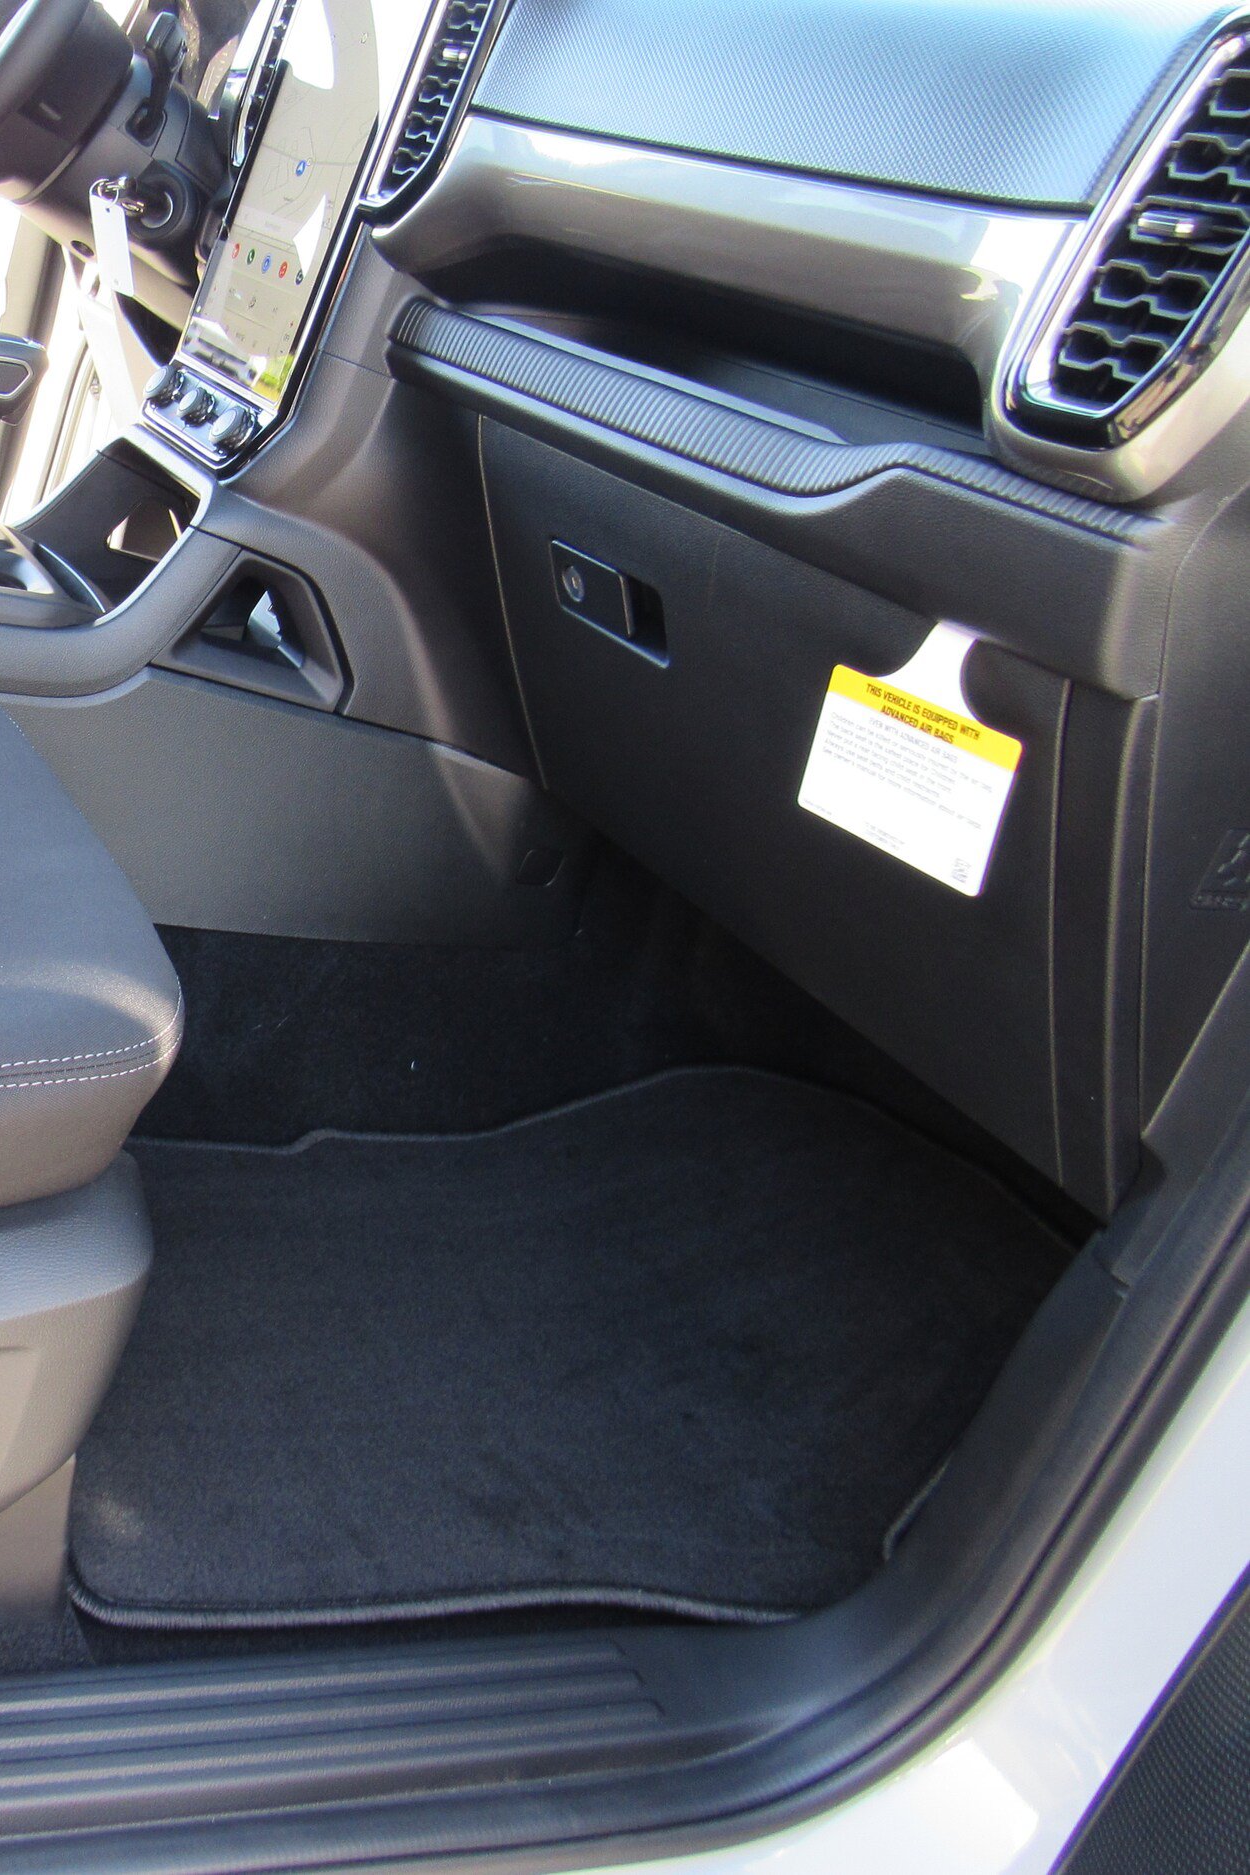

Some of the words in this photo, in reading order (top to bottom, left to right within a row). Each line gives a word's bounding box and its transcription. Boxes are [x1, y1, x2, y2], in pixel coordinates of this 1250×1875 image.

[865, 683, 883, 698] THIS
[882, 690, 912, 711] VEHICLE
[911, 703, 921, 715] IS
[921, 707, 959, 731] EQUIPPED
[958, 723, 981, 741] WITH
[879, 704, 919, 729] ADVANCED
[919, 721, 933, 735] AIR
[933, 727, 955, 744] BAGS
